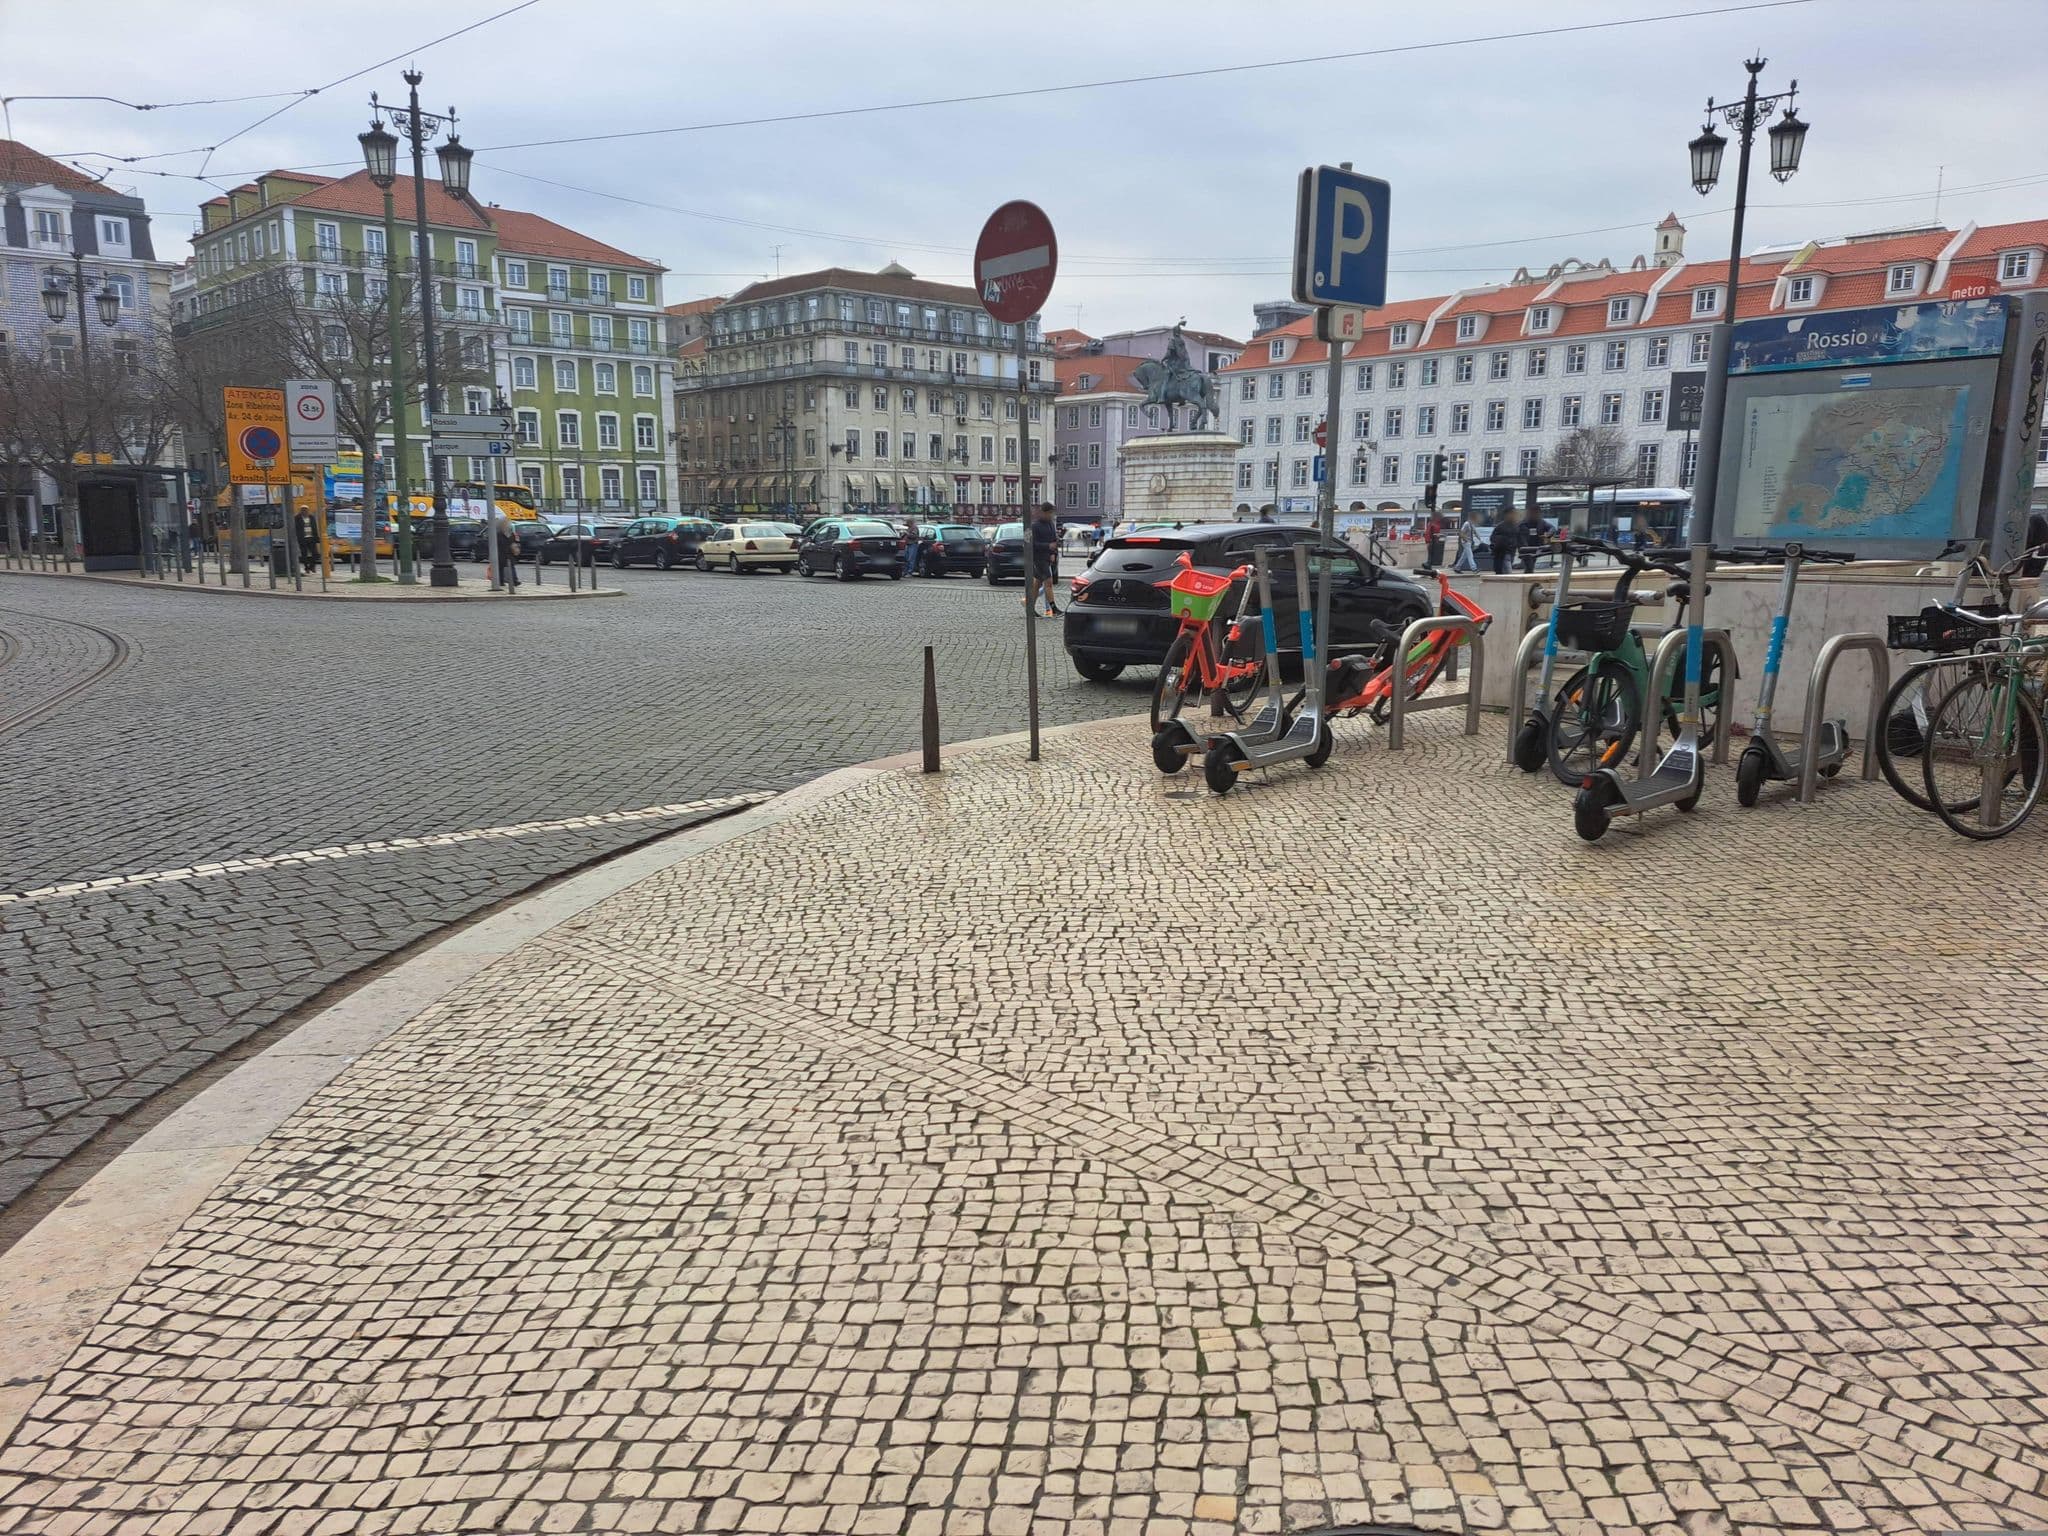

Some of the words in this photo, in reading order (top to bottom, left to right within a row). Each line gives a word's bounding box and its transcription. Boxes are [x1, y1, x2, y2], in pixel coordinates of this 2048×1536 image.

[1330, 186, 1373, 287] P
[1952, 286, 1986, 300] metro
[1807, 328, 1868, 350] Rossio
